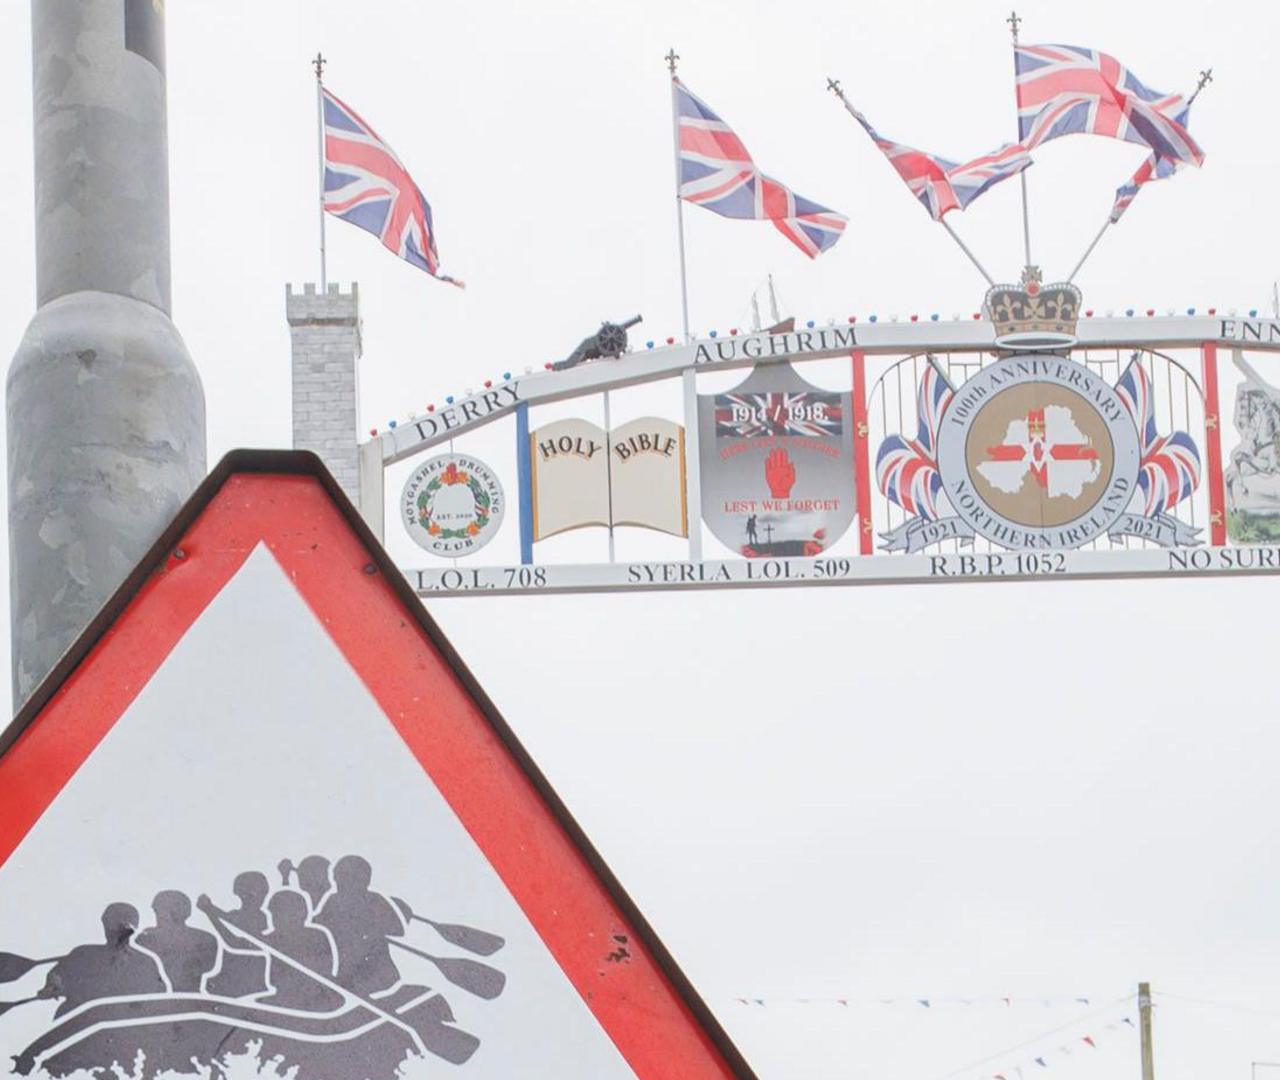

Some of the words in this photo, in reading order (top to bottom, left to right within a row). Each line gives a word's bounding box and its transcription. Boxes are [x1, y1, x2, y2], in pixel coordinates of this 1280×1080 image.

[694, 327, 861, 364] AUGHRIM
[951, 387, 987, 427] 100th
[989, 360, 1125, 424] ANNIVERSARY
[414, 380, 522, 441] DERRY
[730, 405, 767, 424] 1914
[538, 435, 603, 460] HOLY
[614, 432, 677, 461] BIBLE
[724, 501, 757, 513] LEST
[761, 501, 783, 512] WE
[786, 500, 840, 512] FORGET
[951, 479, 1051, 547] NORTHERN
[1058, 476, 1129, 547] IRELAND
[921, 521, 958, 543] 1921
[1124, 518, 1162, 540] 2021
[432, 539, 474, 551] CLUB
[628, 563, 731, 583] SYERLA
[747, 561, 805, 579] LOL.
[813, 559, 851, 577] 509
[930, 556, 1005, 576] R.B.P.
[1015, 552, 1067, 573] 1052
[1169, 550, 1212, 570] NO
[417, 569, 495, 590] L.O.L.
[504, 567, 546, 588] 708
